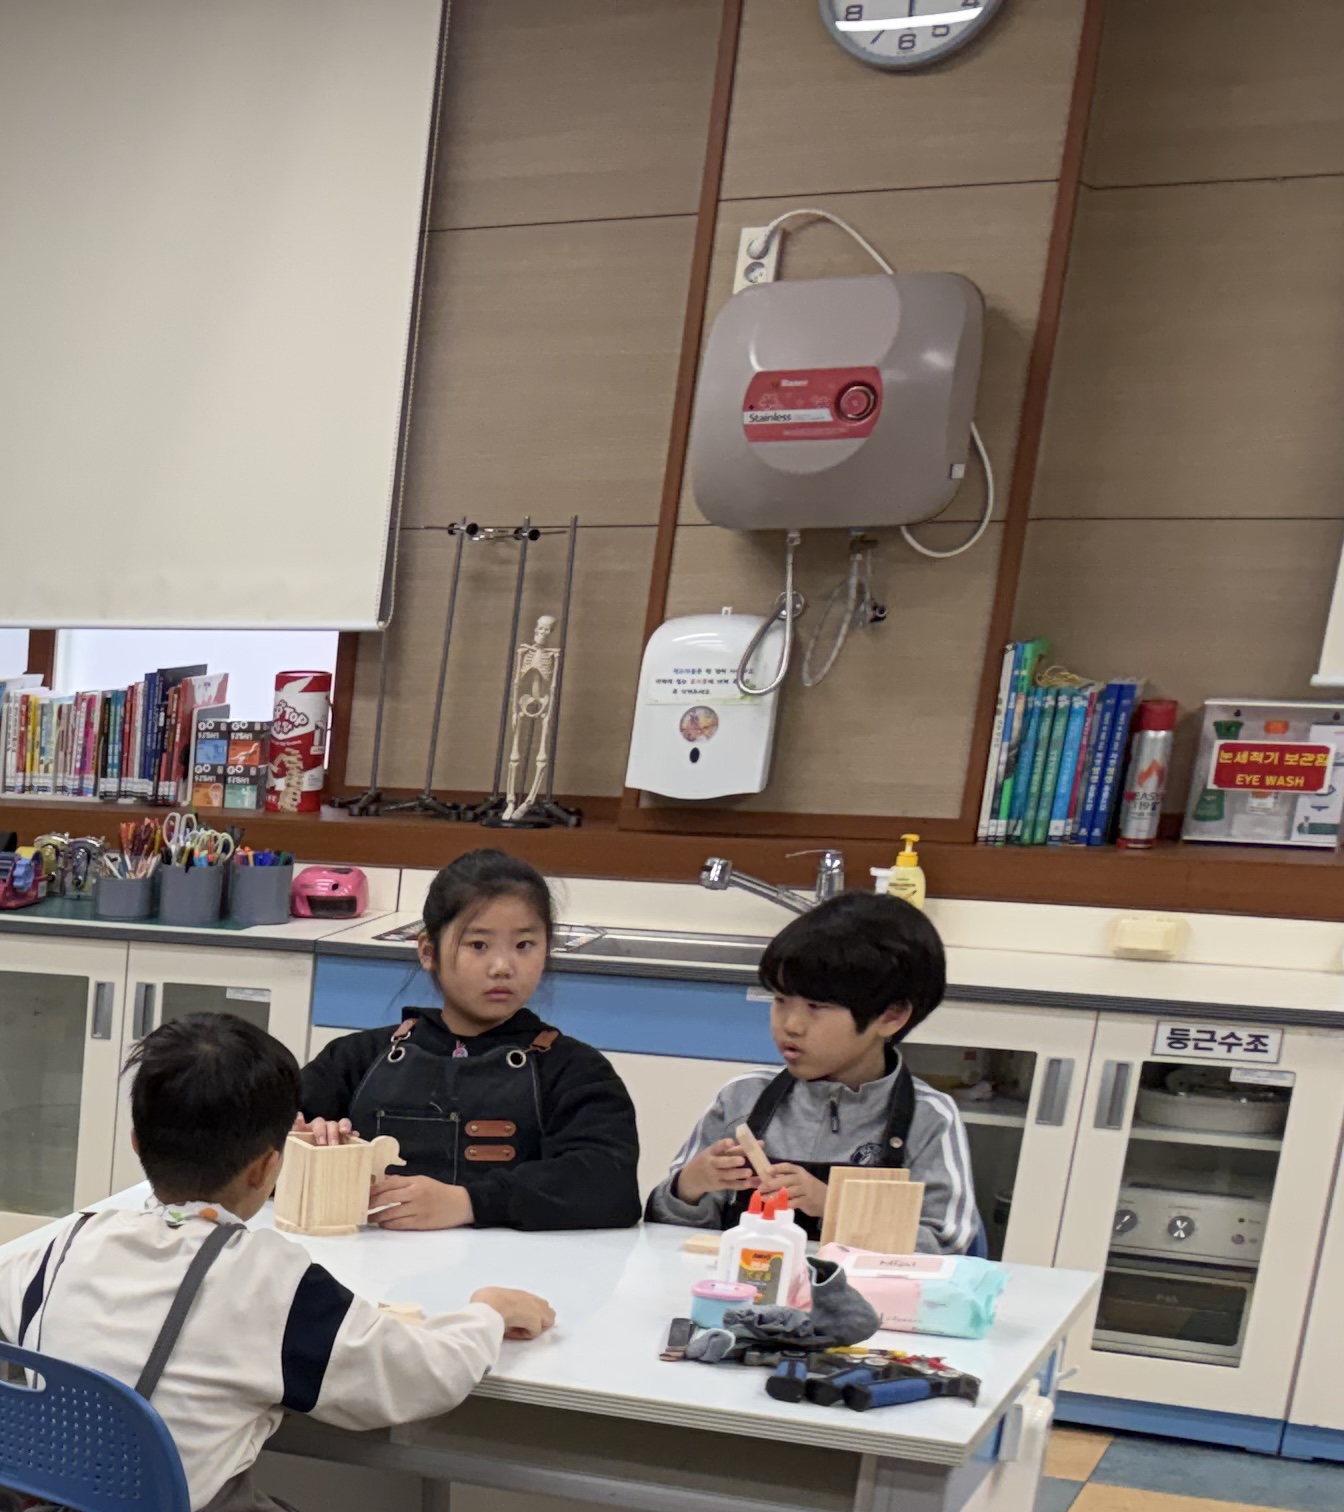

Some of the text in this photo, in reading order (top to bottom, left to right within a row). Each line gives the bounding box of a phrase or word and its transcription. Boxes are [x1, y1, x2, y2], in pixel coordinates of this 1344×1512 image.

[845, 5, 863, 21] 8
[898, 33, 916, 50] 6
[1235, 773, 1305, 787] EYE WASH
[1166, 1027, 1270, 1053] 둥근수조
